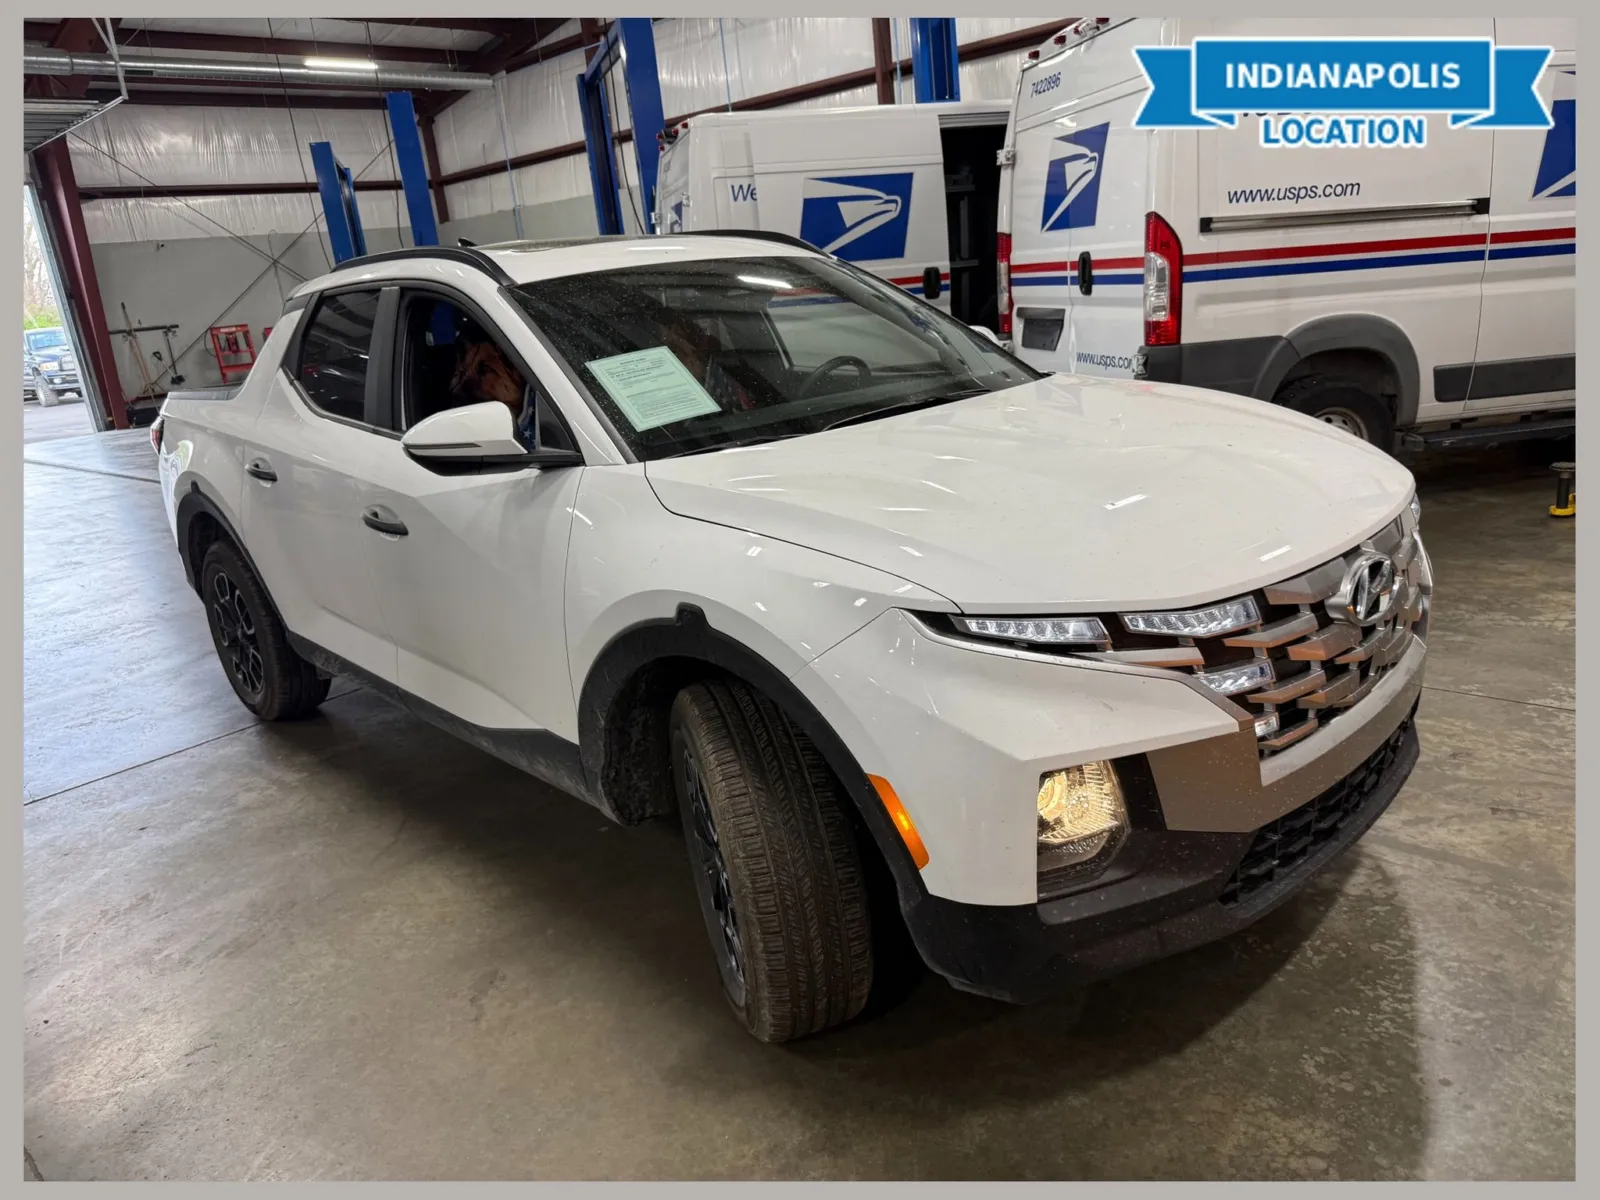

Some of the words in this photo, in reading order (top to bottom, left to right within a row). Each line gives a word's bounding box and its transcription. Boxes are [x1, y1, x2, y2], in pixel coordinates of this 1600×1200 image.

[1030, 71, 1062, 98] 7422896
[730, 183, 758, 203] We
[1227, 182, 1361, 204] www.usps.com
